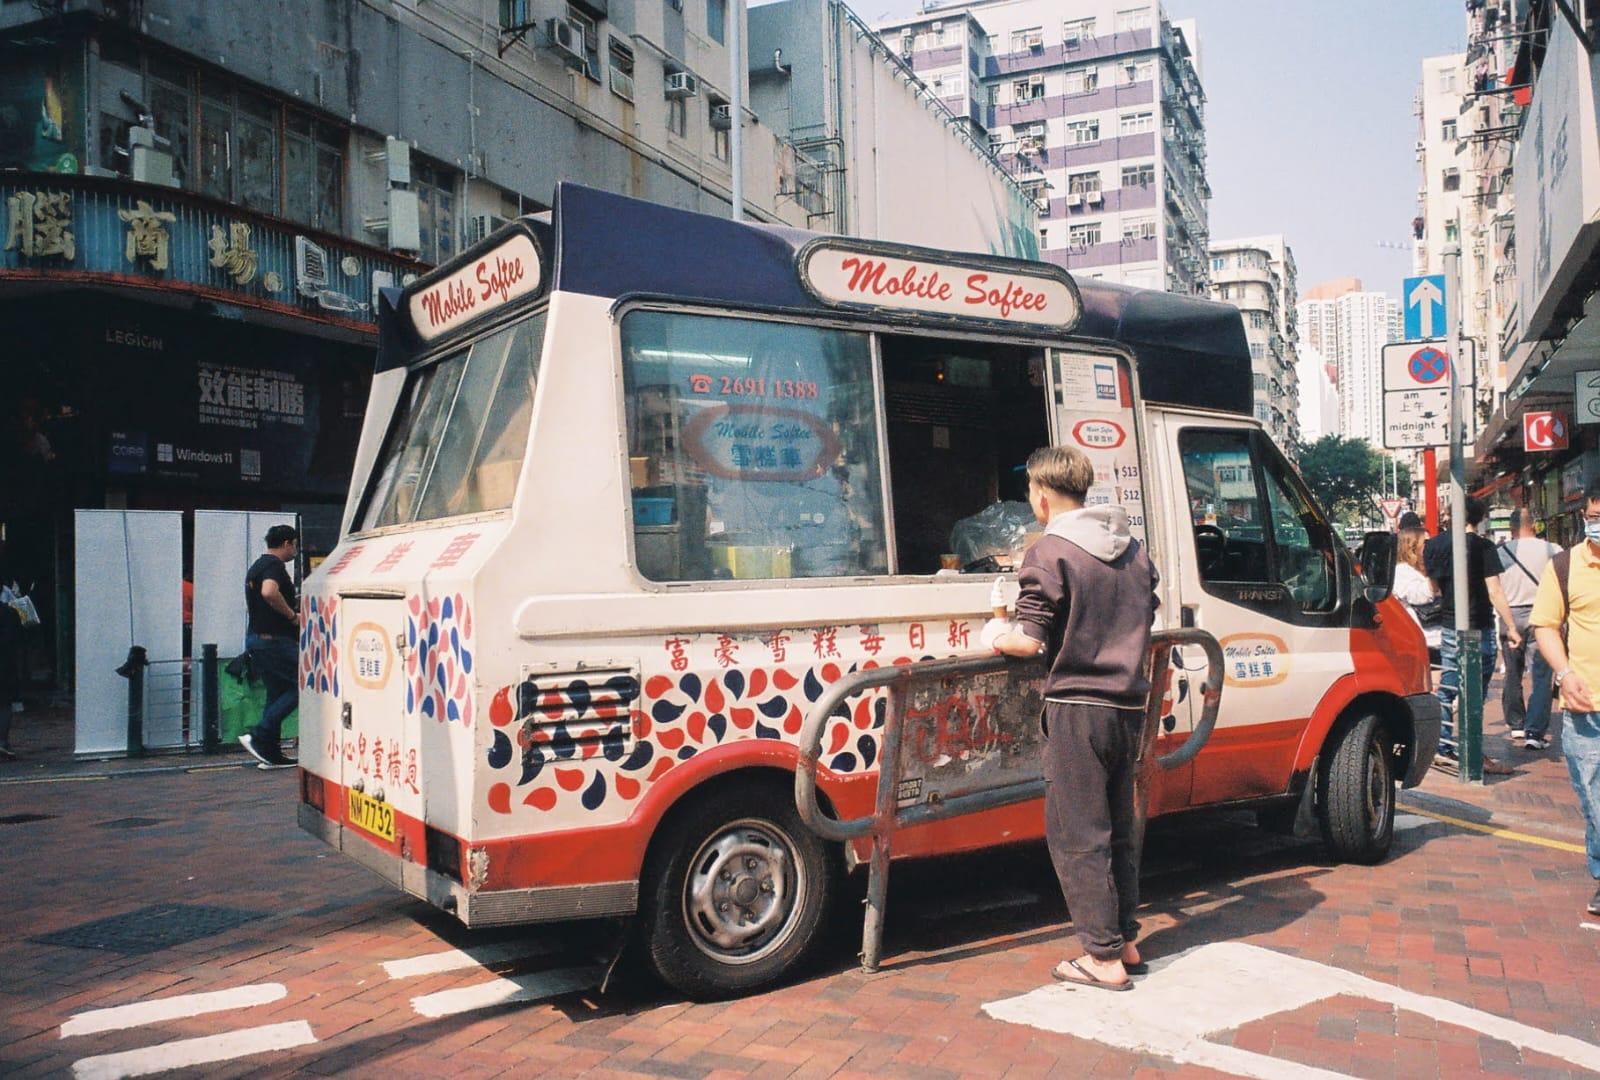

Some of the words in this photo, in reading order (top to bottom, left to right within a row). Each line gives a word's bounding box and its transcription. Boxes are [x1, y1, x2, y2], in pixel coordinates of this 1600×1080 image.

[421, 279, 476, 328] Mobile
[476, 256, 524, 303] Softee
[841, 257, 952, 301] Mobile
[964, 273, 1048, 318] Softee
[105, 329, 164, 351] LEGION
[198, 366, 304, 416] 效能制勝
[720, 376, 766, 396] 2691
[775, 378, 818, 399] 1388
[1403, 392, 1420, 400] am
[1400, 401, 1425, 412] 上午
[1389, 421, 1436, 432] midnight
[1401, 433, 1425, 443] 午夜
[731, 444, 803, 468] 雪糕車
[1122, 466, 1138, 477] $13
[1124, 490, 1139, 500] $12
[1235, 661, 1273, 678] 雪糕車
